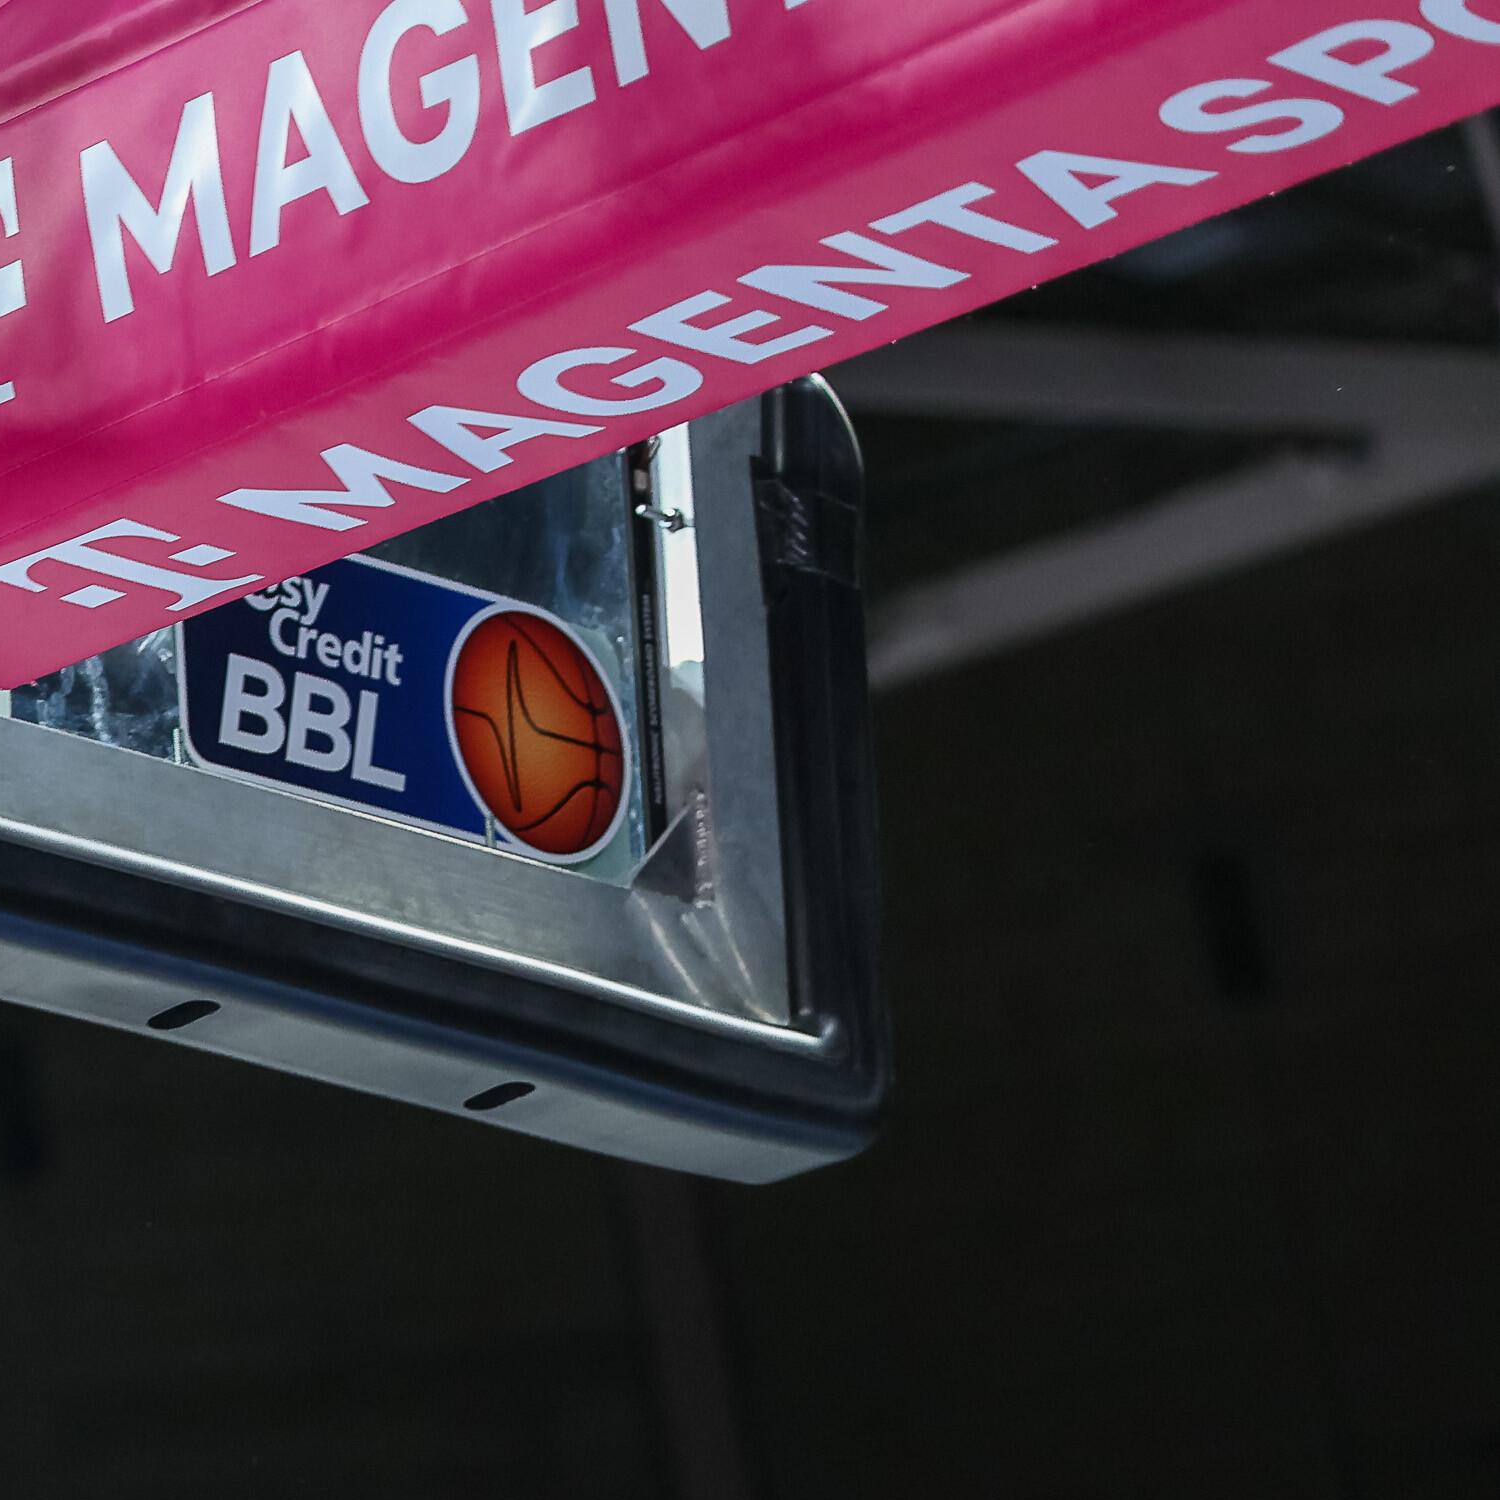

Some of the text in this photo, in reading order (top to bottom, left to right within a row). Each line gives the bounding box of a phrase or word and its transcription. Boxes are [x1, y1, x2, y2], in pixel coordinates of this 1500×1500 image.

[215, 150, 1218, 532] MAGENTA
[269, 607, 404, 686] Credit
[218, 652, 406, 792] BBL
